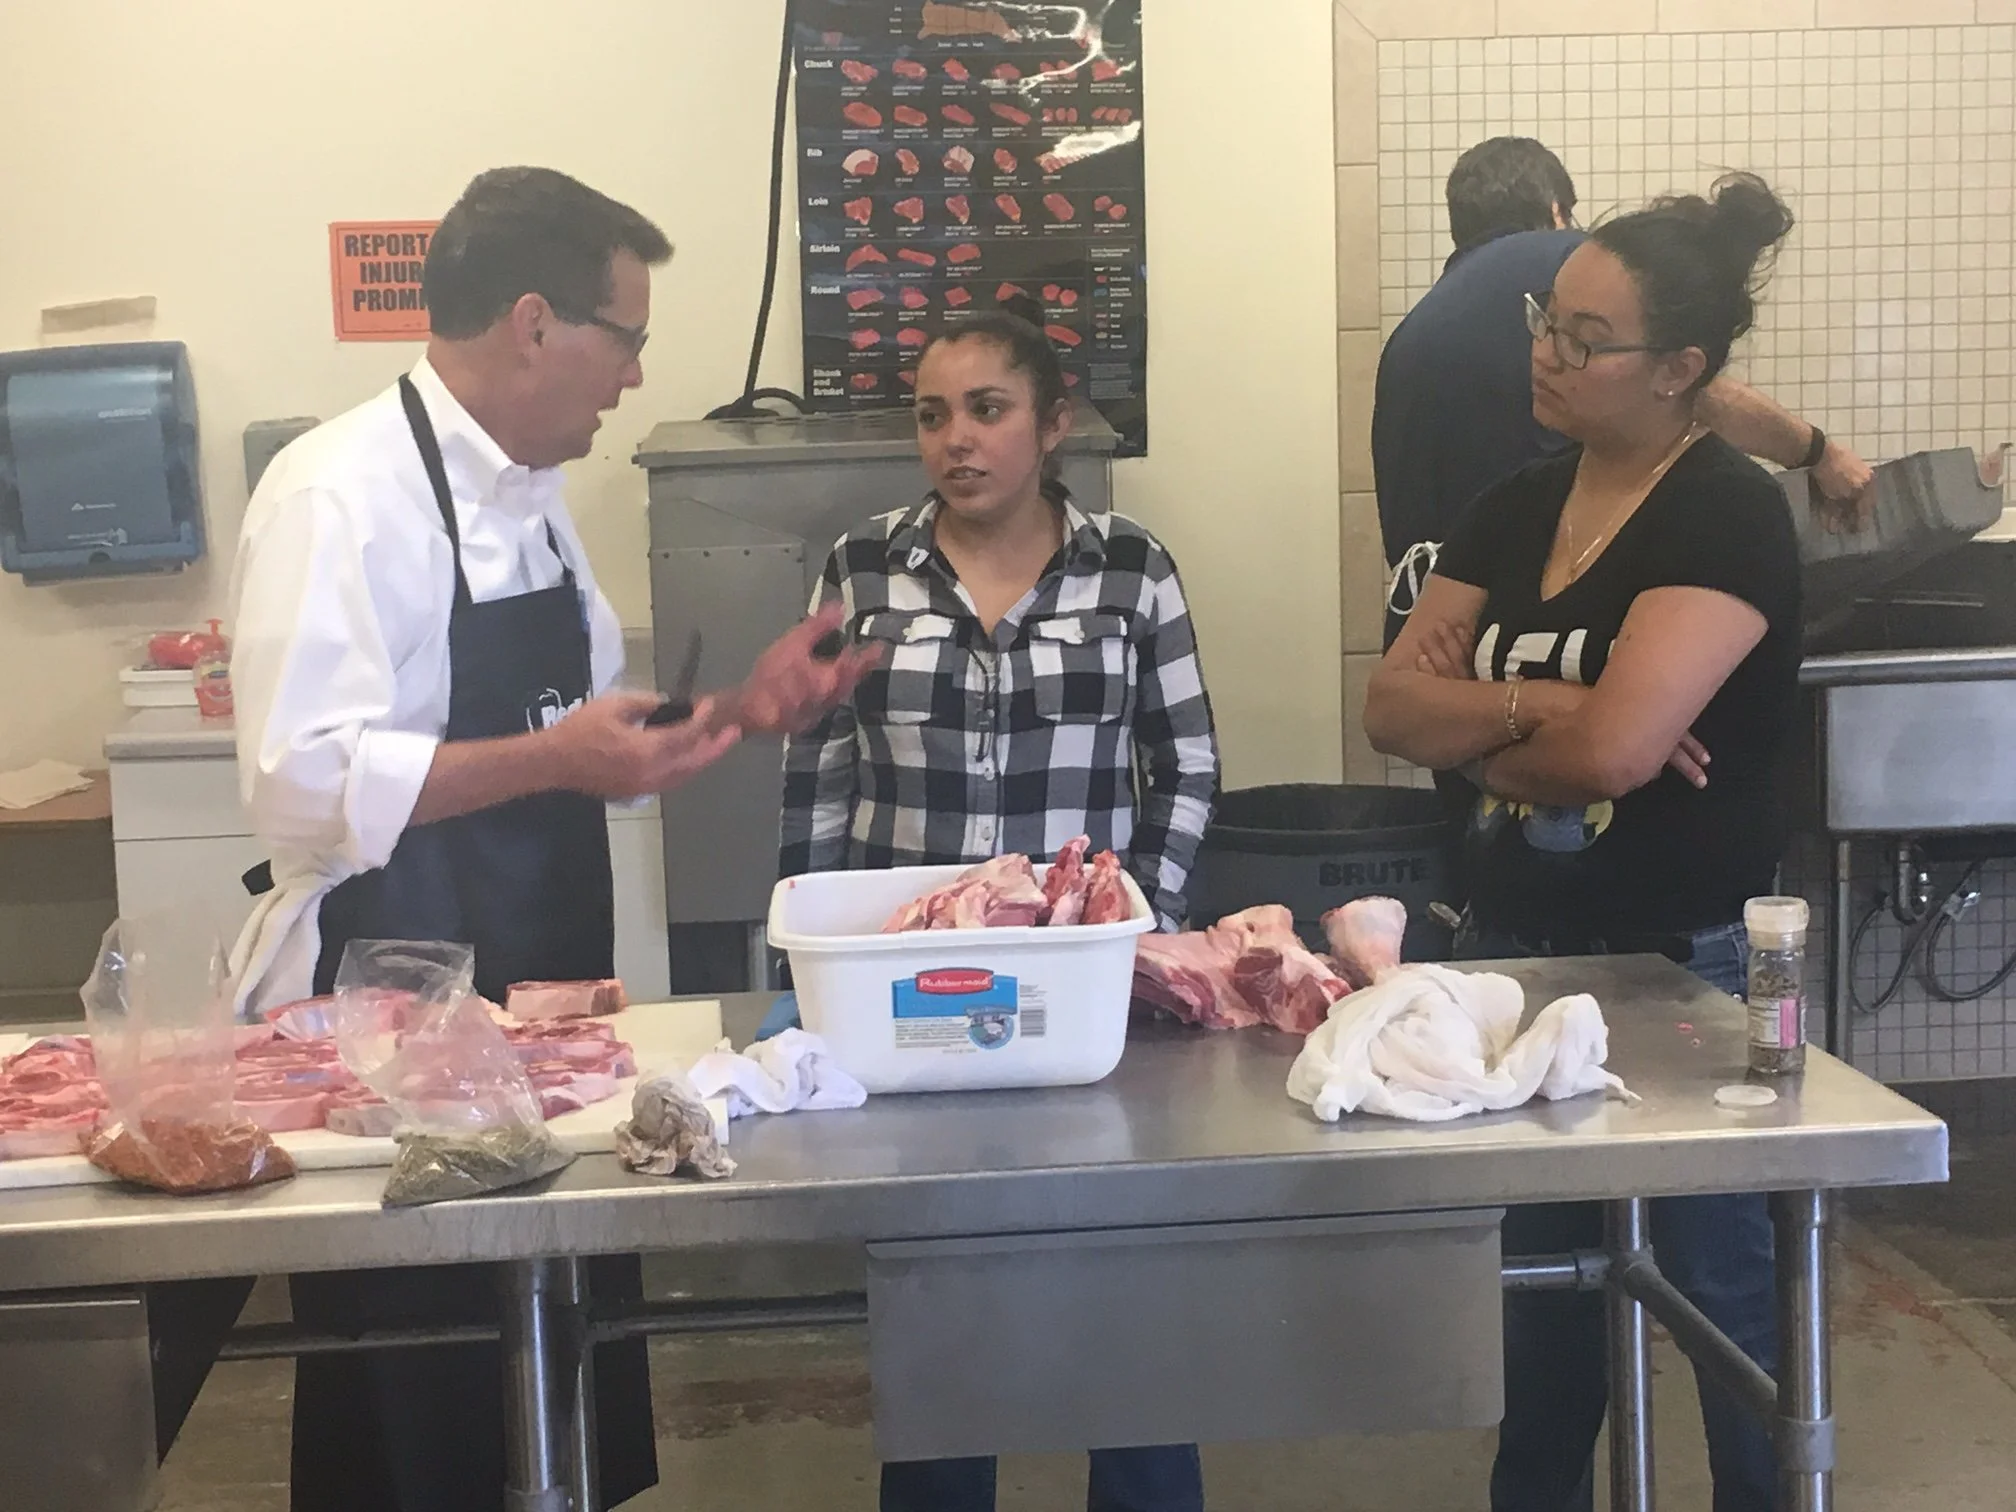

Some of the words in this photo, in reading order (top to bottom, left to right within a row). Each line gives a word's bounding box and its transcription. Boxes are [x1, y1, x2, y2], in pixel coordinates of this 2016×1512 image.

[804, 59, 833, 68] Chuck
[806, 148, 823, 157] Rib
[807, 197, 829, 206] Loin
[344, 233, 428, 257] REPORT
[809, 244, 840, 253] Sirloin
[810, 285, 840, 295] Round
[813, 378, 831, 386] and
[1319, 856, 1427, 886] BRUTE
[919, 975, 990, 989] Rubbermaid
